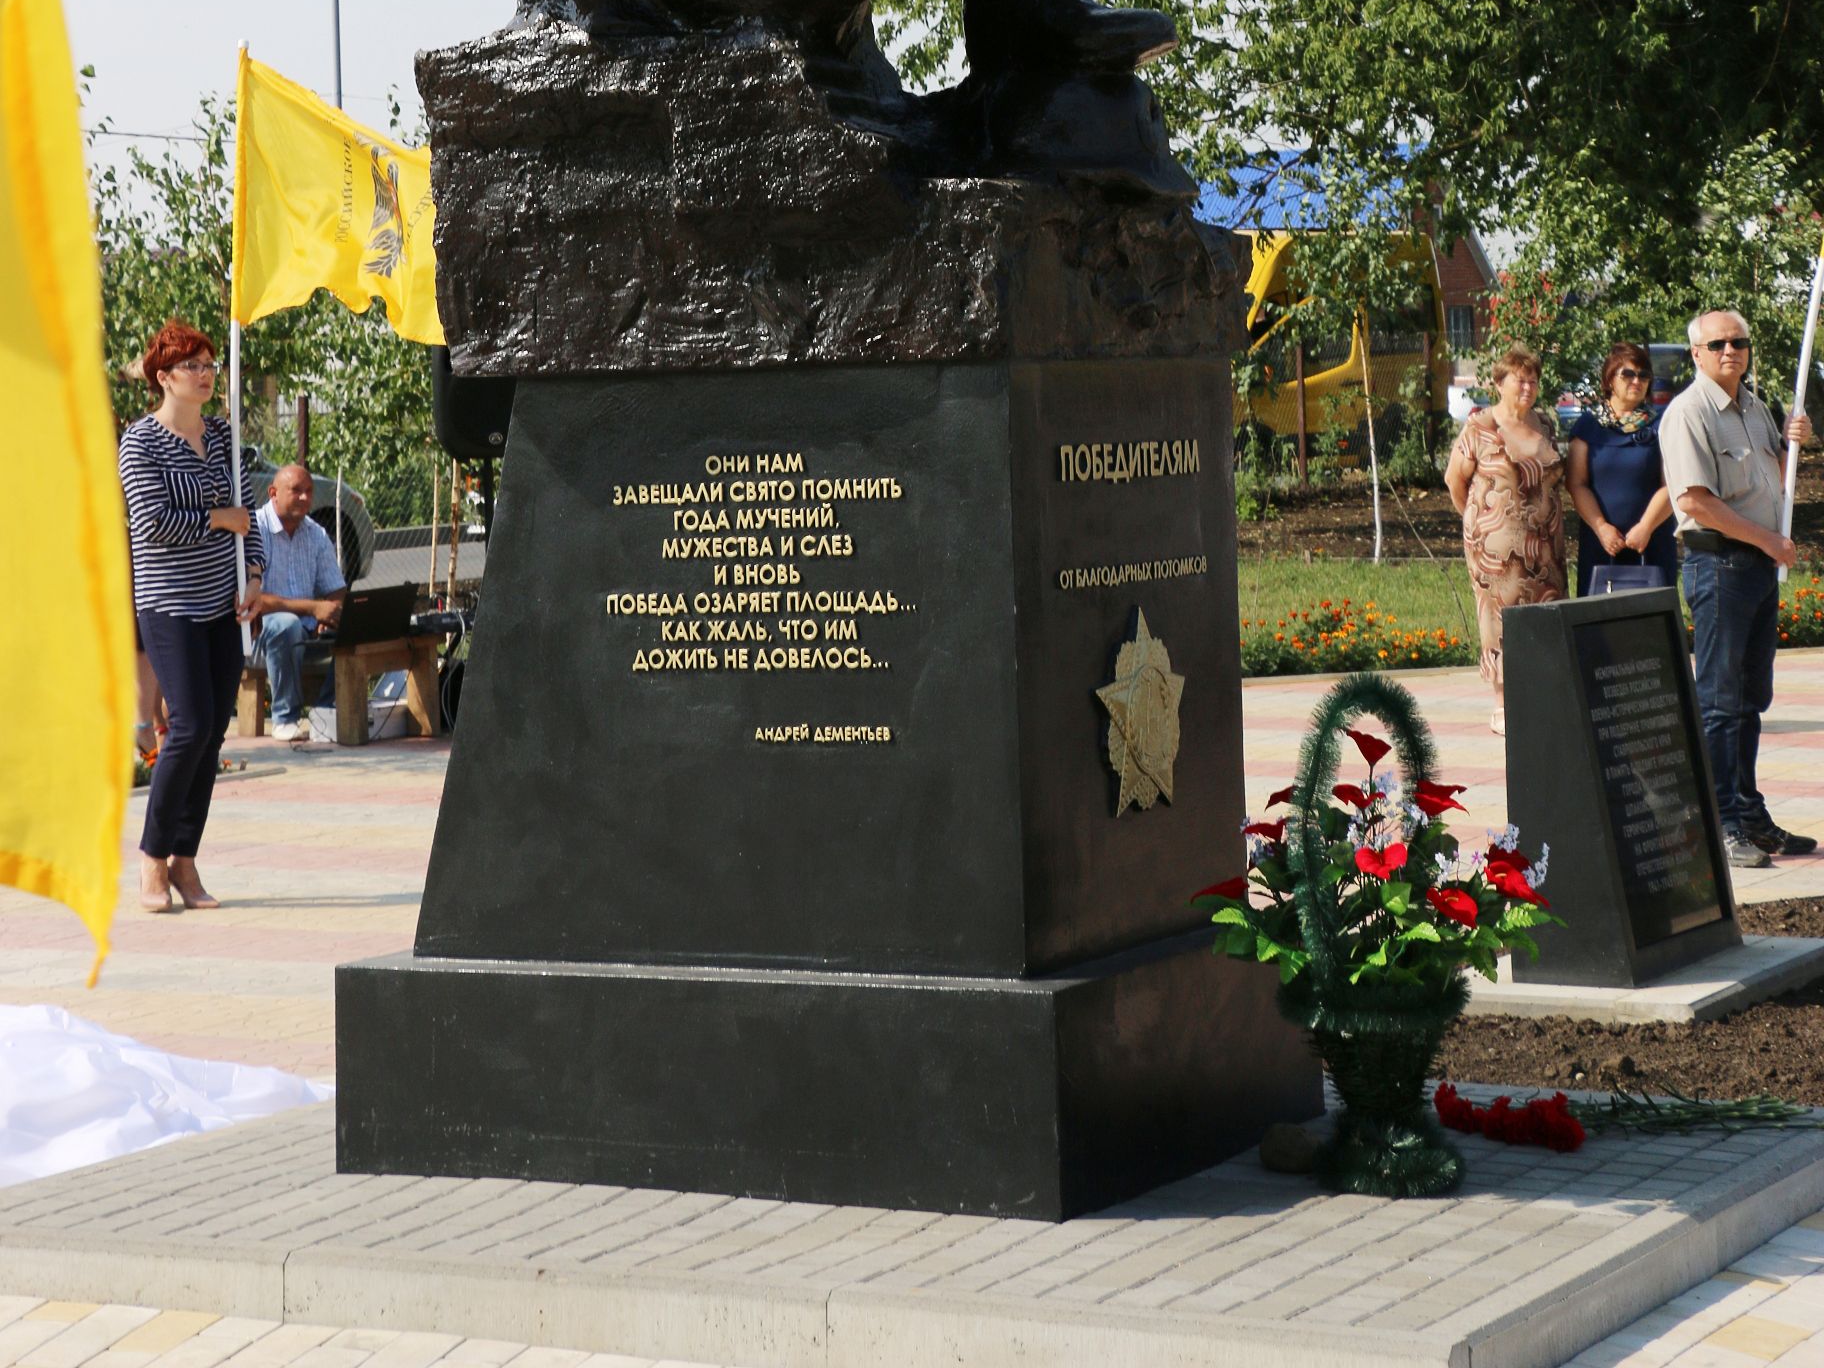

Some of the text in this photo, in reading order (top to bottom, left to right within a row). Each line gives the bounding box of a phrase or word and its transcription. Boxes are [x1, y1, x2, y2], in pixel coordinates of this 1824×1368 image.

[705, 453, 804, 476] ОНИ НАМ
[1060, 440, 1200, 484] ПОБЕДИТЕЛЯМ
[613, 478, 902, 506] ЗАВЕЩАЛИ СВЯТО ПОМНИТЬ
[674, 503, 840, 532] ГОДА МУЧЕНИЙ,
[662, 535, 853, 558] МУЖЕСТВА И СЛЕЗ
[714, 564, 800, 585] И ВНОВЬ
[1060, 555, 1207, 589] ОТ БЛАГОДАРНЫХ ПОТОМКОВ
[606, 591, 916, 616] ПОБЕДА ОЗАРЯЕТ ПЛОЩАДЬ...
[662, 620, 857, 642] КАК ЖАЛЬ, ЧТО ИМ
[633, 649, 717, 671] ДОЖИТЬ
[725, 649, 748, 669] НЕ
[755, 724, 890, 741] АНДРЕЙ ДЕМЕНТЬЕВ
